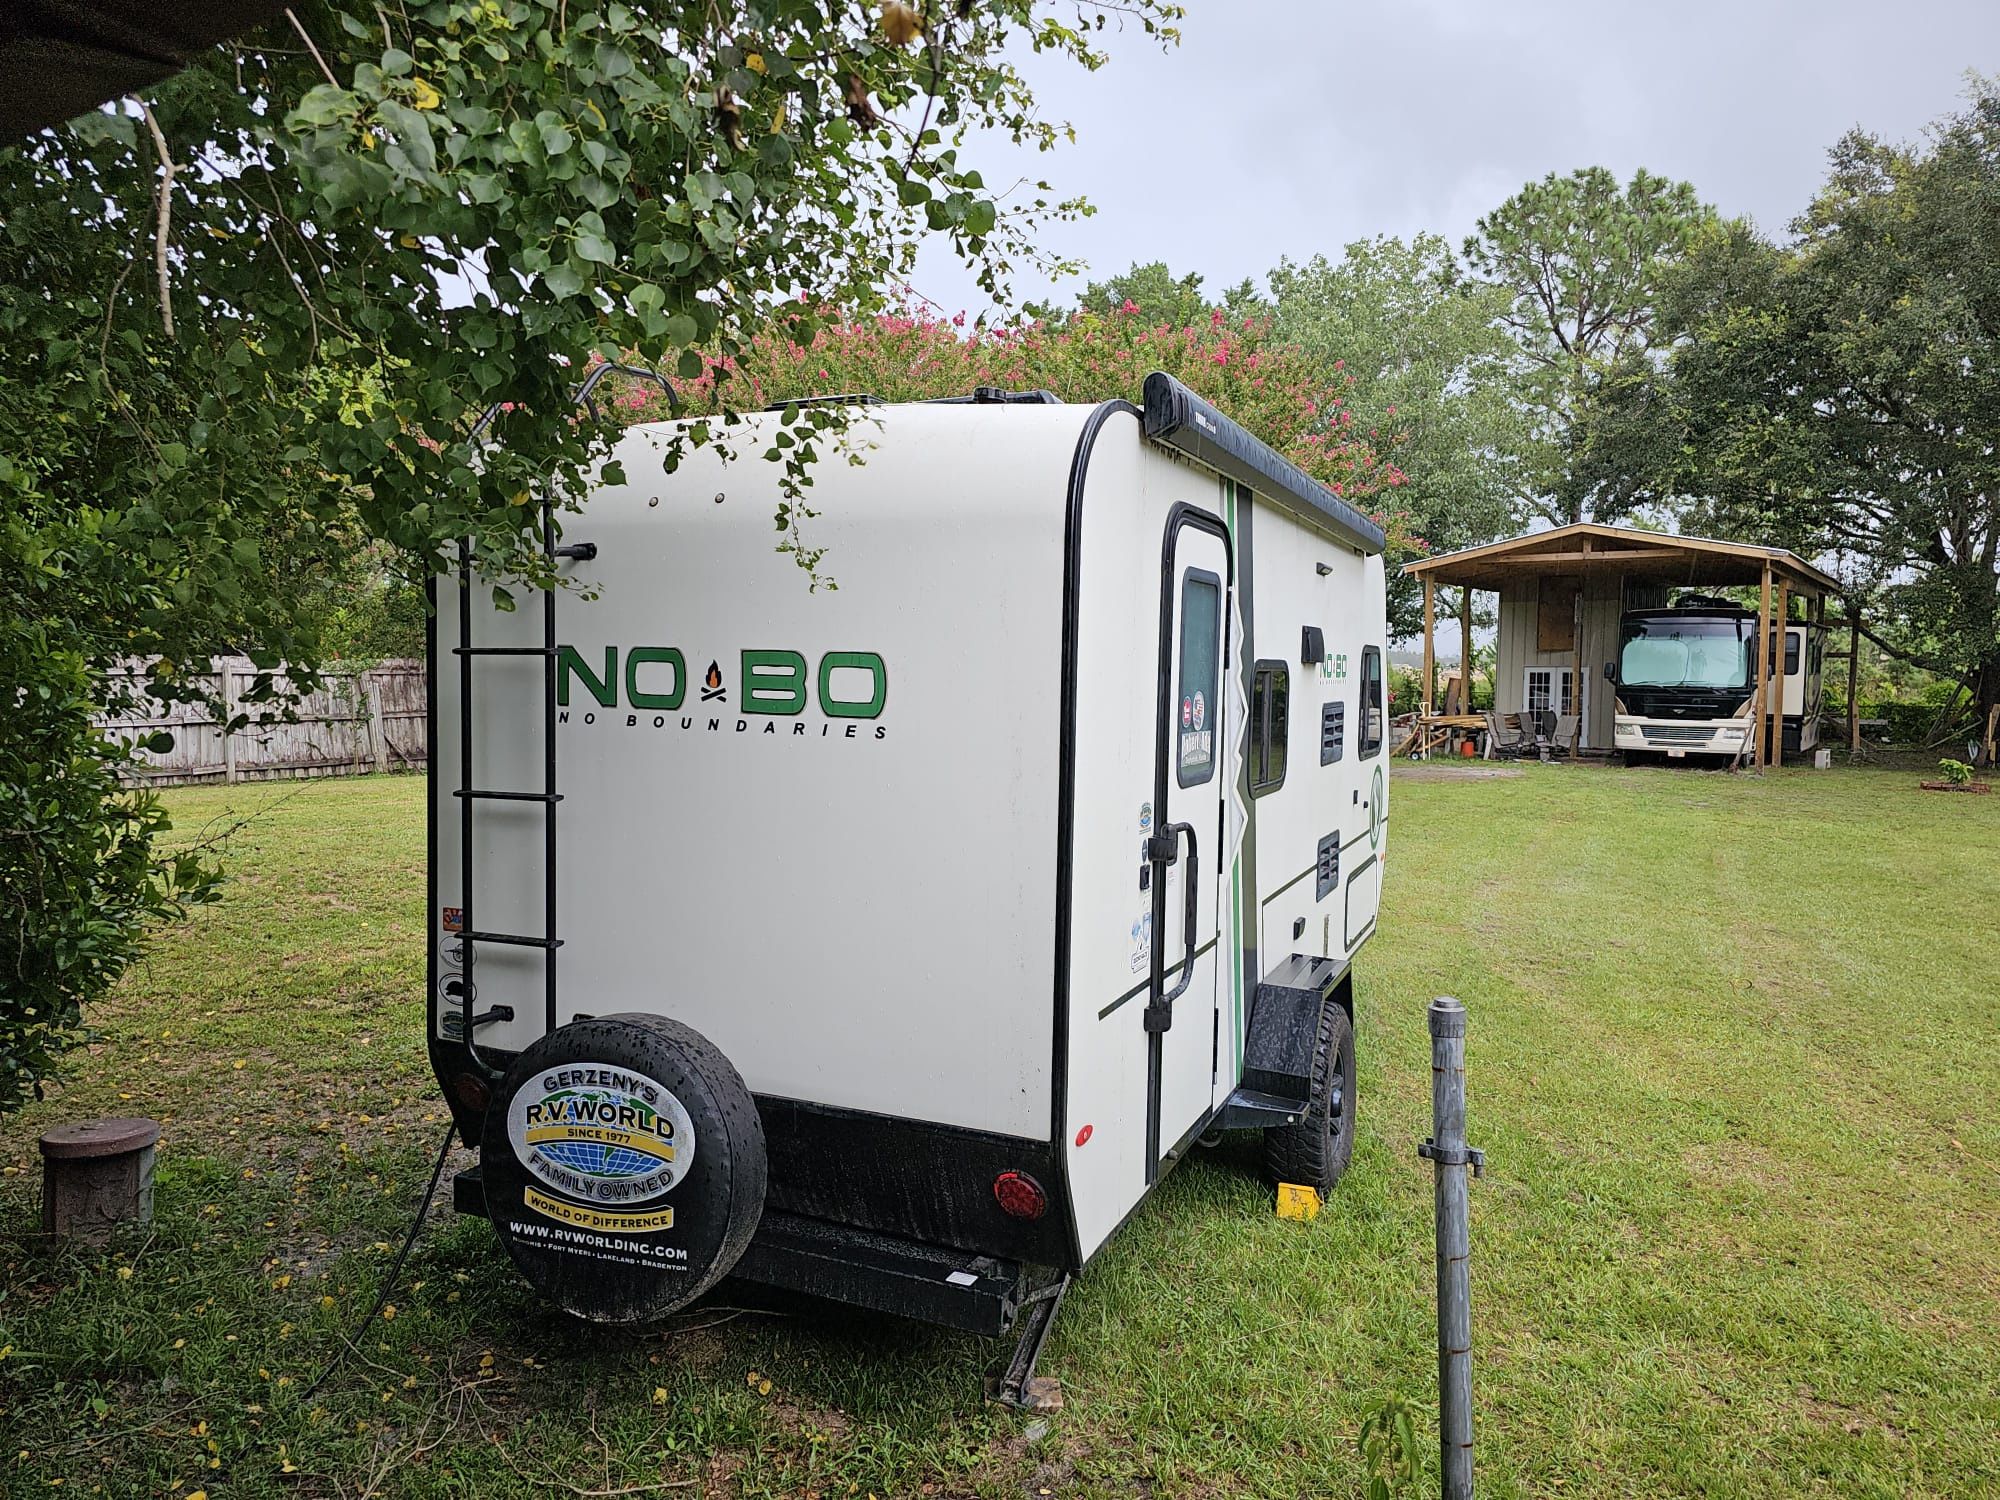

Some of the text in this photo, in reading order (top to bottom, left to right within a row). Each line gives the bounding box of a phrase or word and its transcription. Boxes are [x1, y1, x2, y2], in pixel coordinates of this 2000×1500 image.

[556, 645, 888, 720] NO BO
[559, 711, 887, 740] NO BOUNDARIES
[543, 1069, 659, 1103] GERZENY'S
[567, 1128, 631, 1144] SINCE 1977
[528, 1151, 674, 1199] FAMILY OWNED
[530, 1195, 669, 1229] WORLD OF DIFFERENCE
[509, 1221, 688, 1261] WWW.RVWORLDINC.COM
[597, 1252, 635, 1265] LAKELAND
